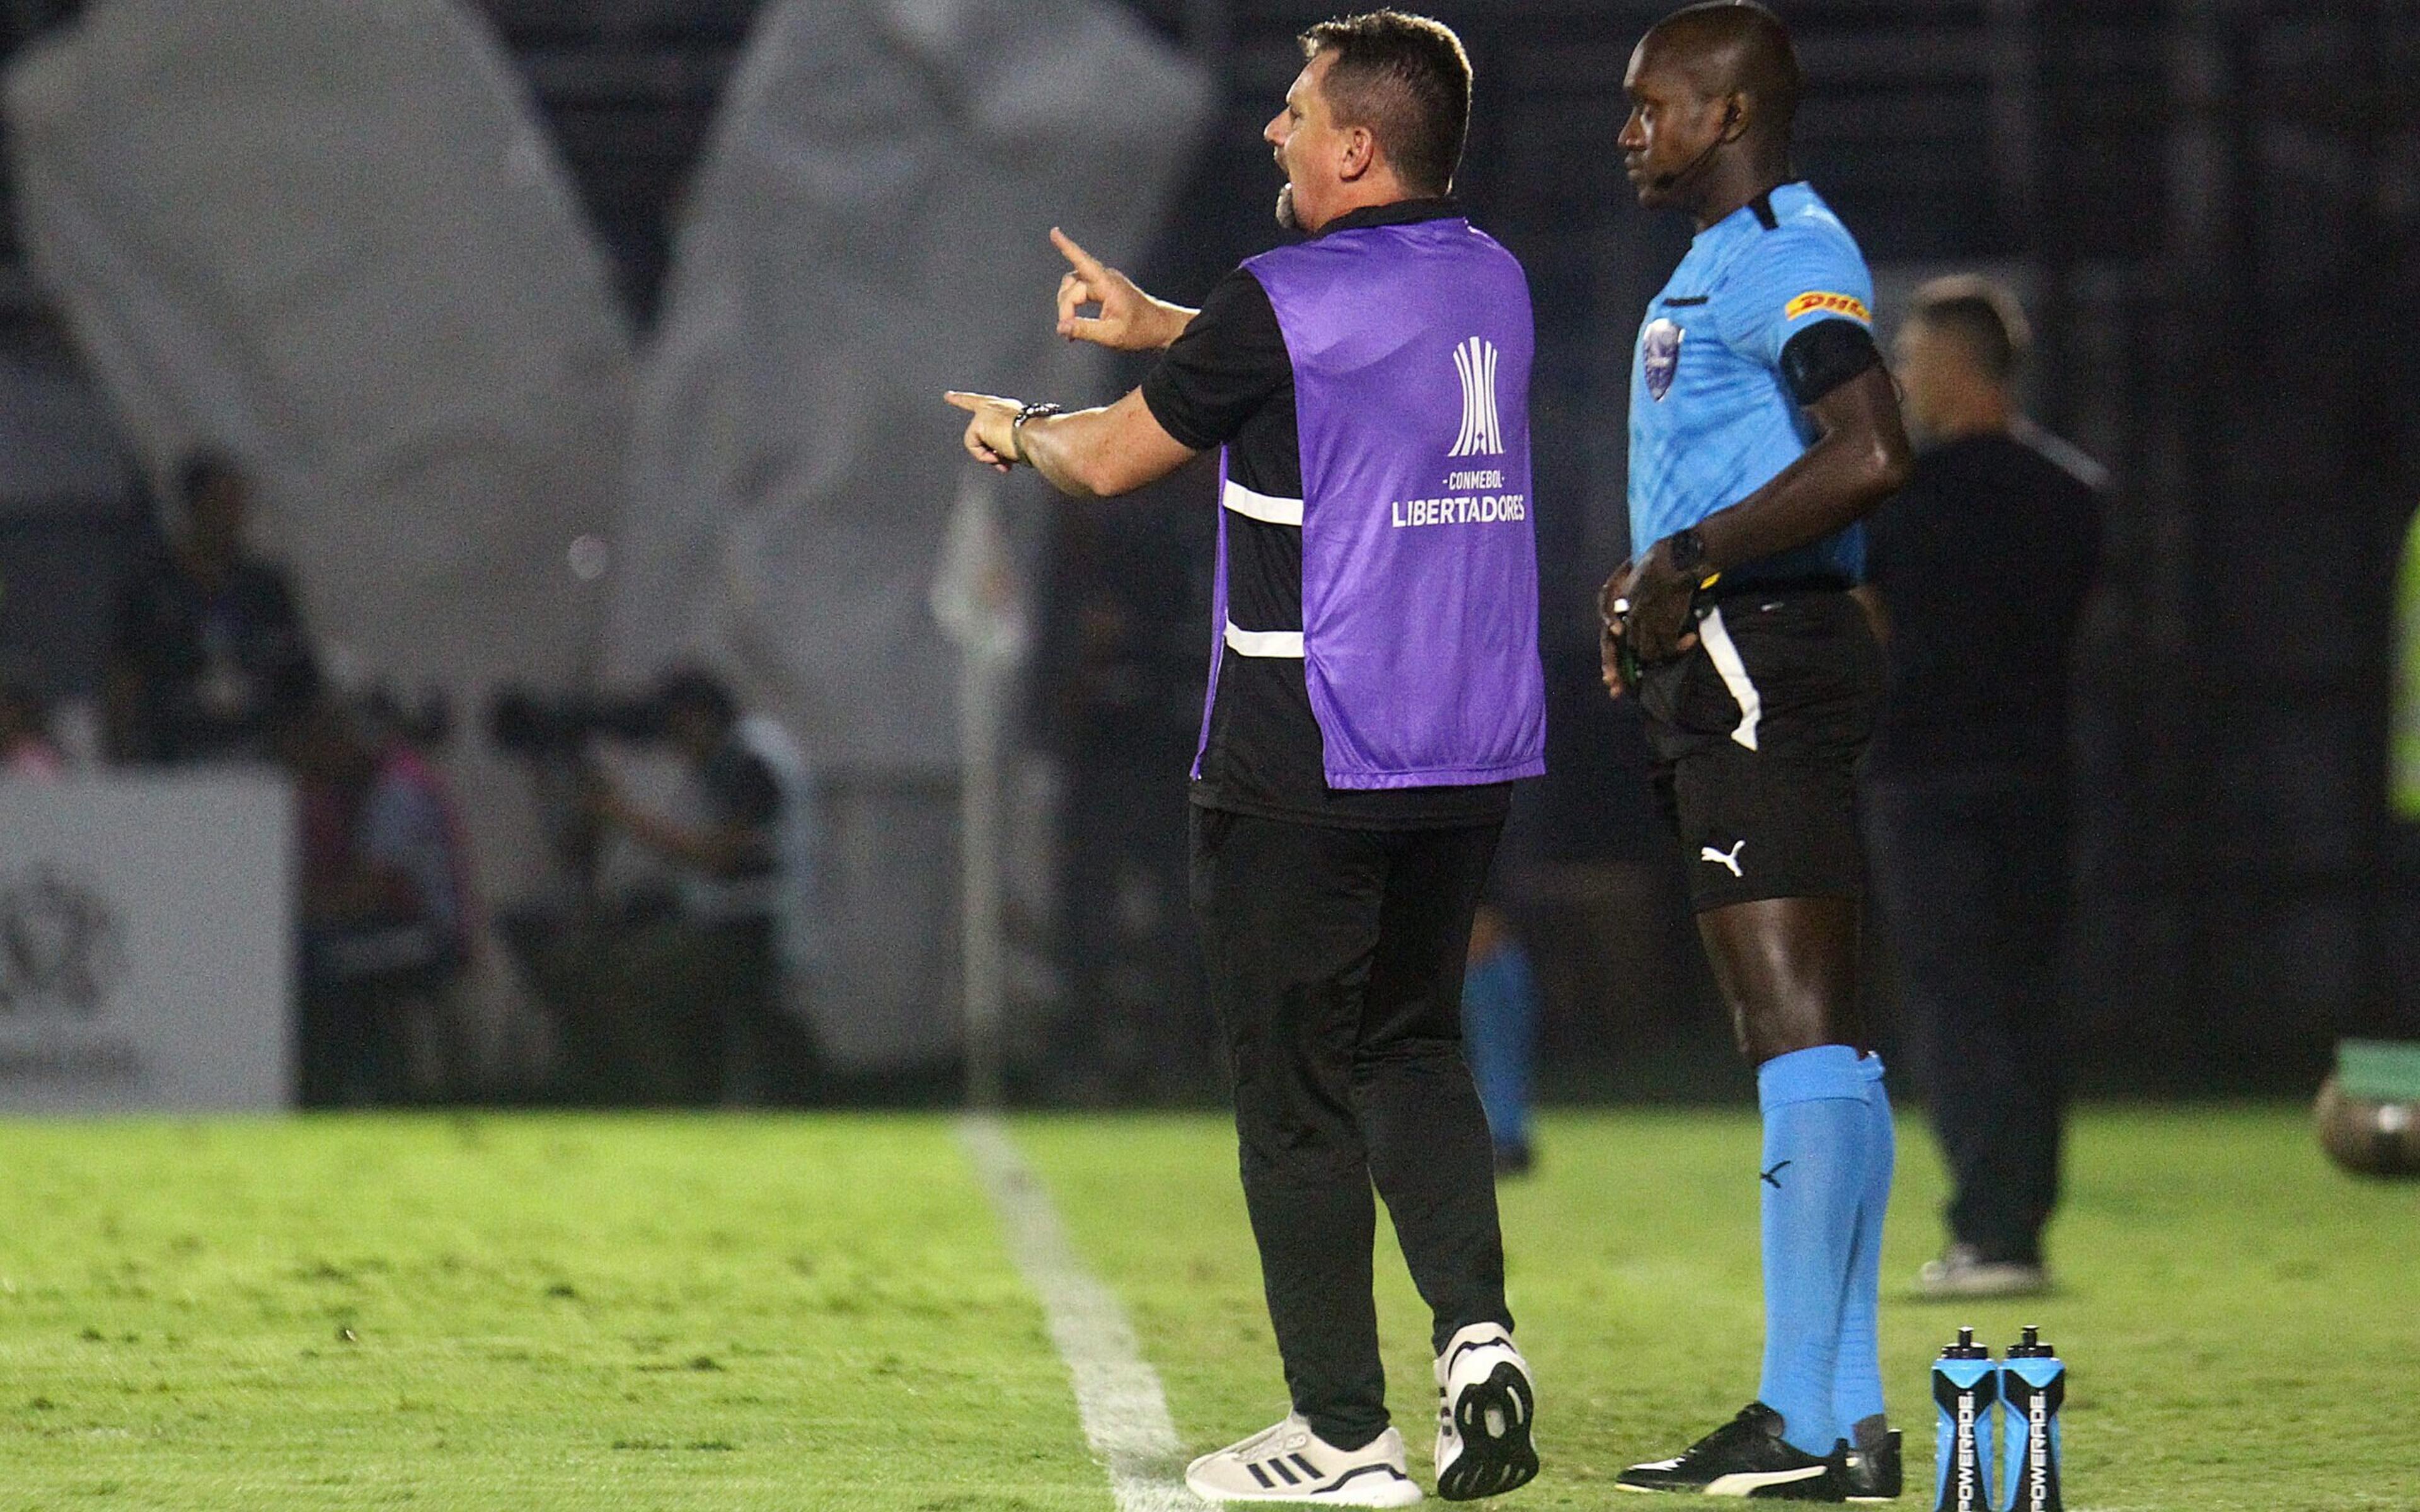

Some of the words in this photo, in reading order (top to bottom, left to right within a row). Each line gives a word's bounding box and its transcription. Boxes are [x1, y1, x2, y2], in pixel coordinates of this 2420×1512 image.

[1800, 294, 1865, 316] DHL
[1392, 495, 1525, 528] LIBERTADORES
[1957, 1395, 1974, 1512] POWERADE
[2029, 1395, 2047, 1512] POWERADE
